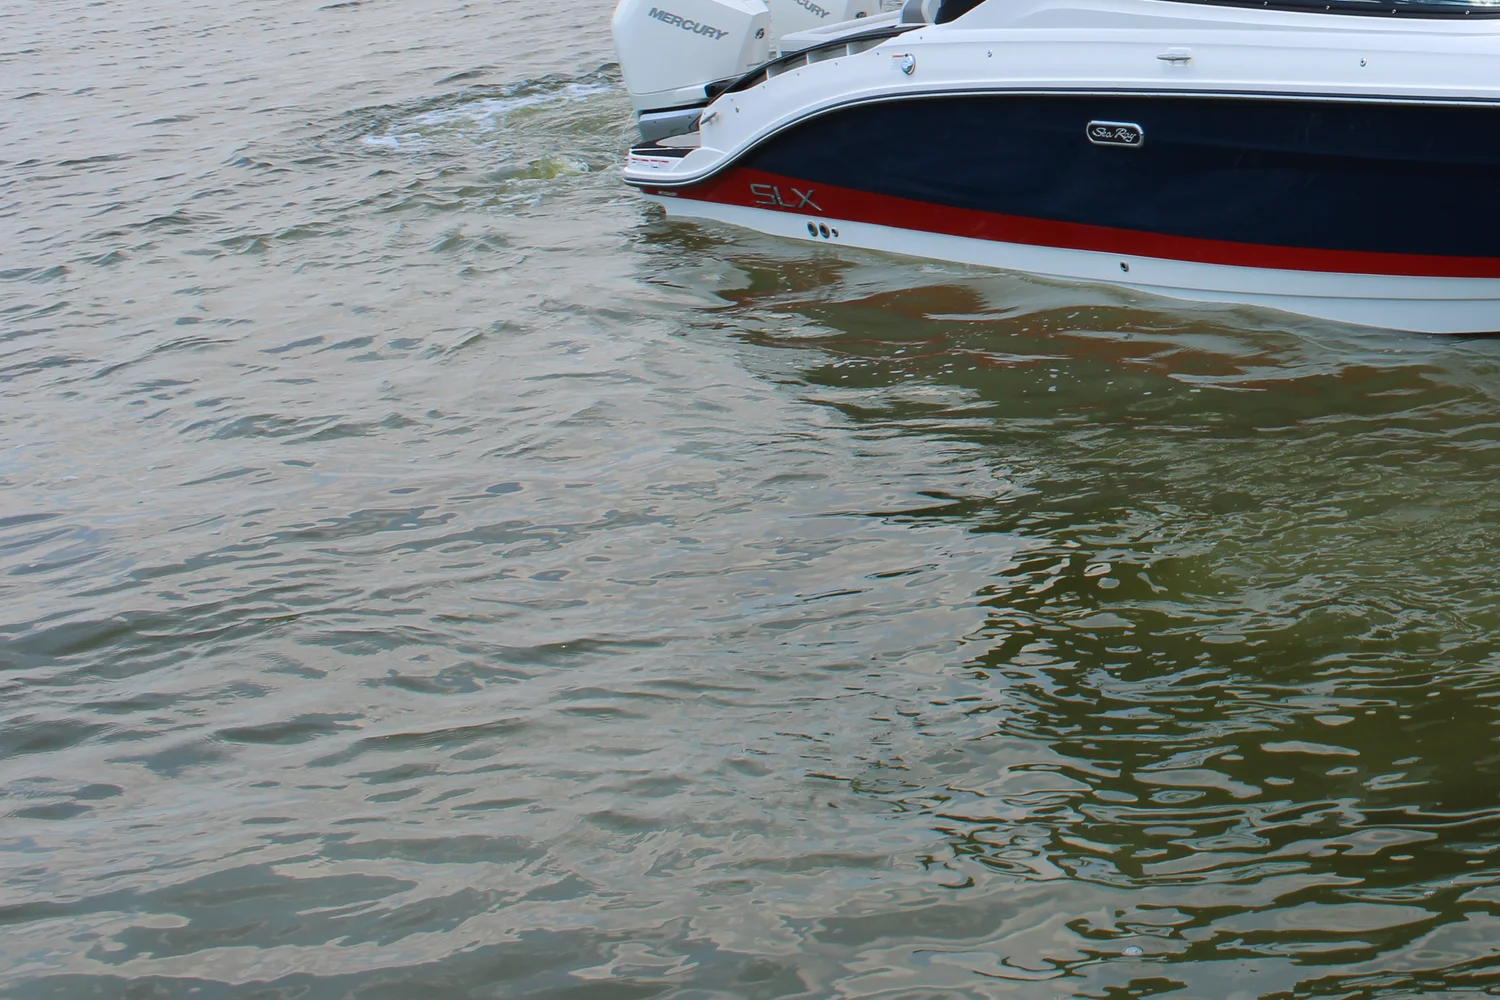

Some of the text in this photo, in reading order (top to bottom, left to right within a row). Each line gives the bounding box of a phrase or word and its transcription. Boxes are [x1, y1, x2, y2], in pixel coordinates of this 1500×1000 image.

[648, 7, 729, 40] MERCURY
[1092, 127, 1137, 142] Sea Ray
[750, 183, 823, 211] SLX
